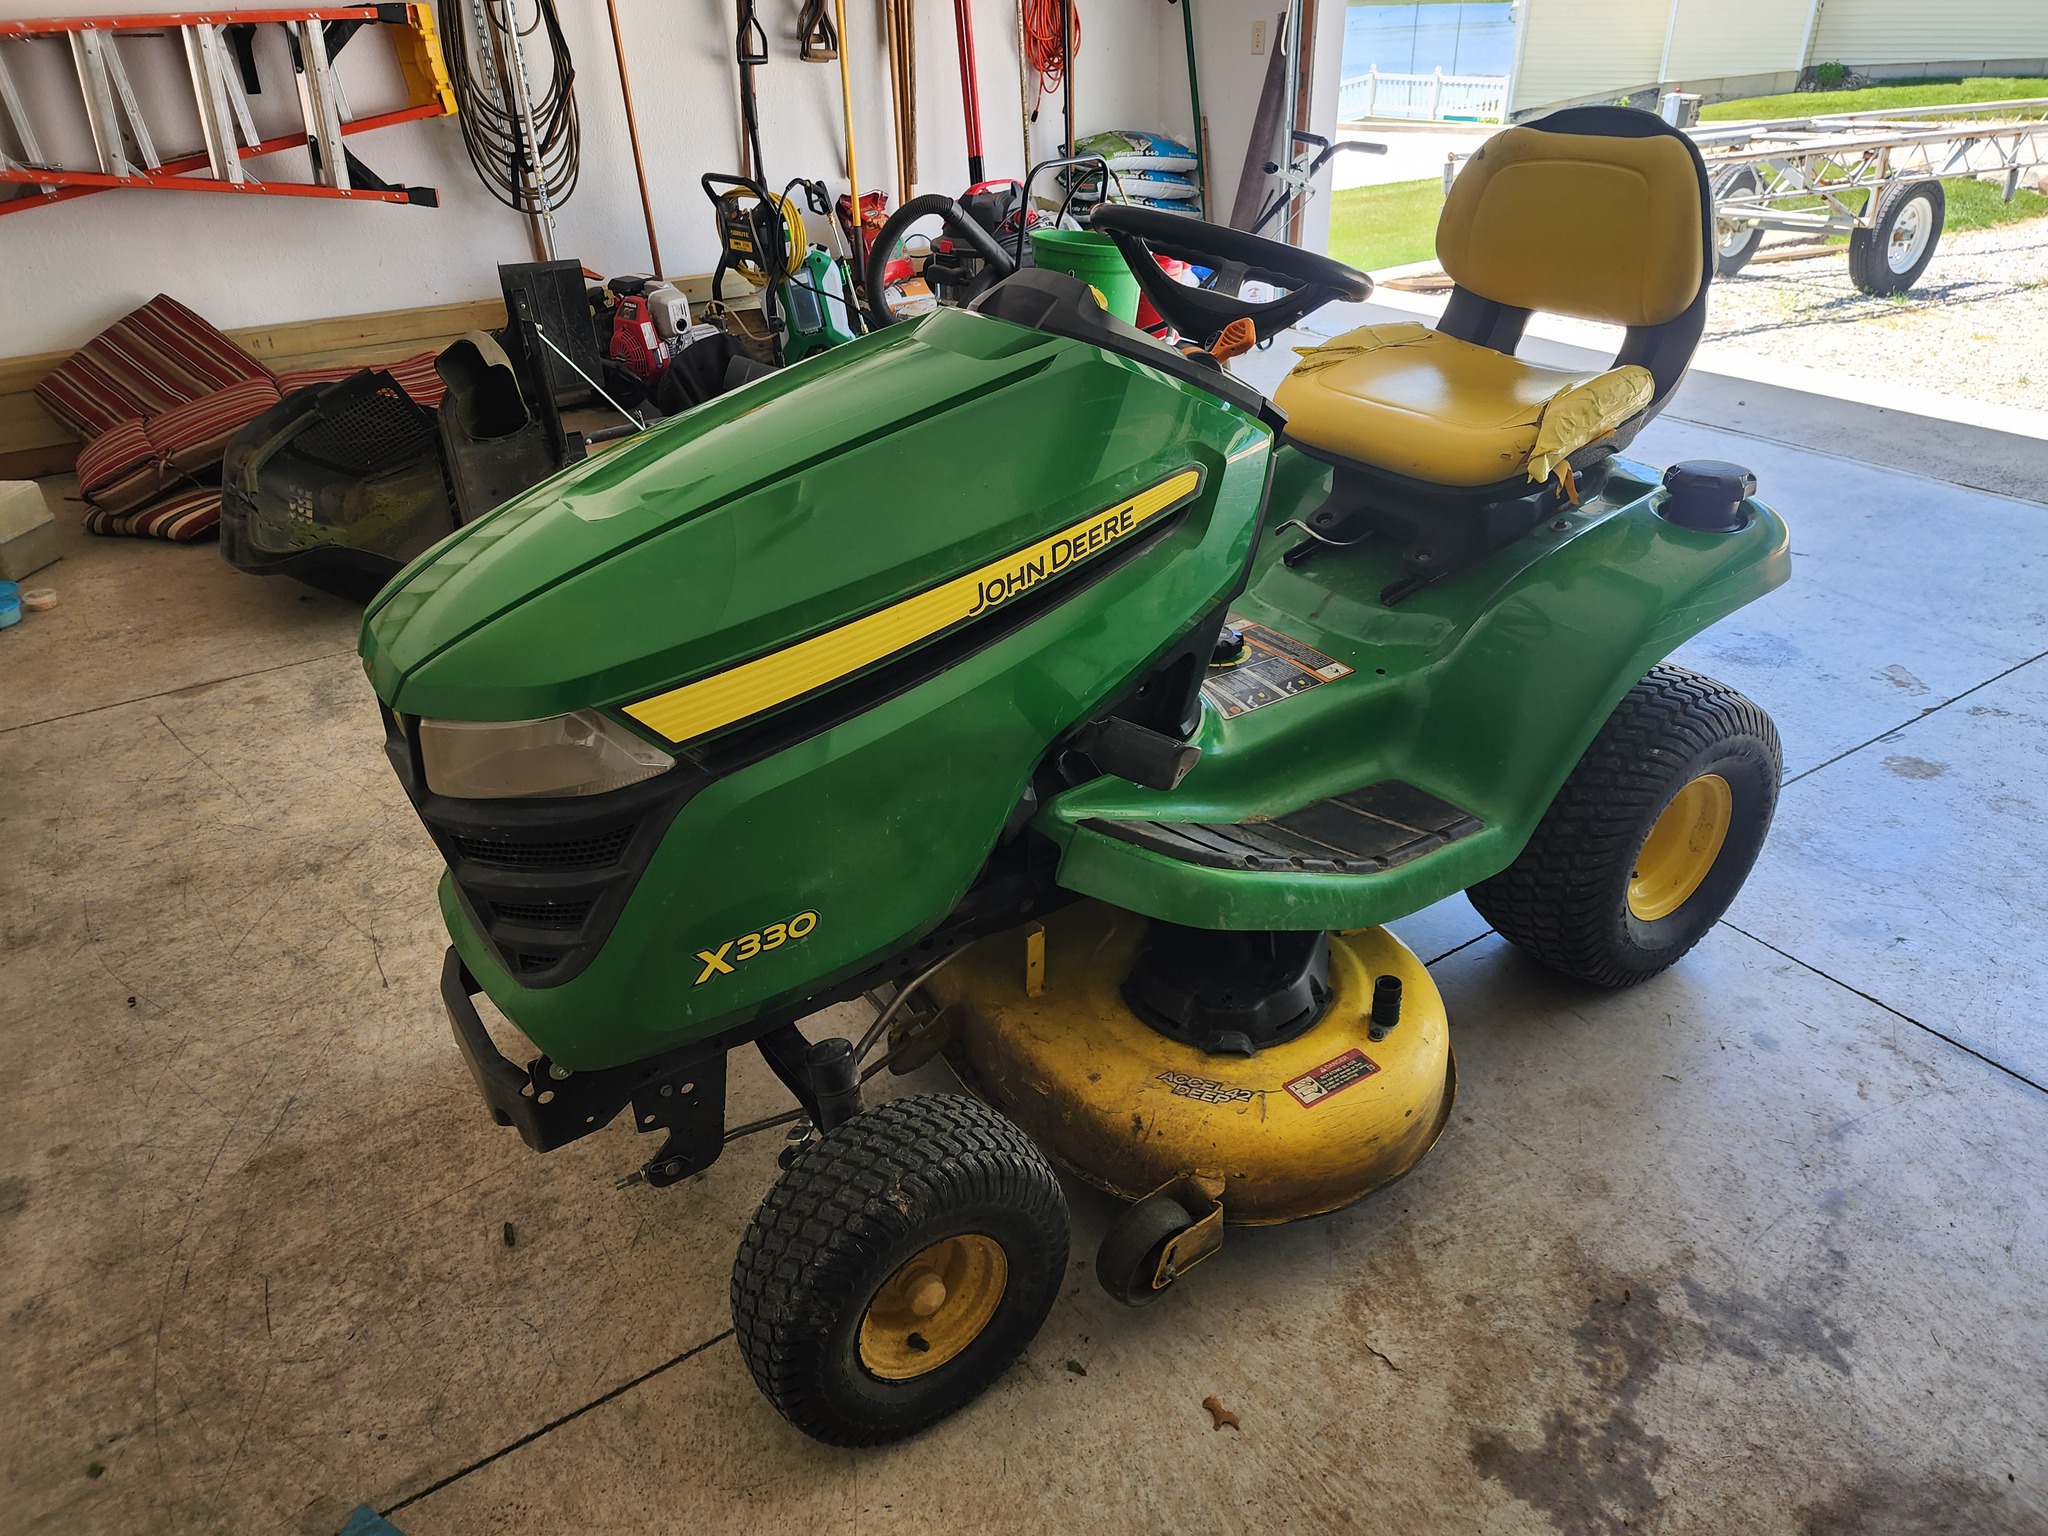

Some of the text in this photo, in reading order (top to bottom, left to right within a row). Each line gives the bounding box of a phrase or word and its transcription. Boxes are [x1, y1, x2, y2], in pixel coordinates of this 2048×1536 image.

[969, 505, 1135, 615] JOHN DEERE
[693, 910, 819, 986] X330
[1325, 1055, 1349, 1069] DANGER
[1156, 1071, 1253, 1103] ACCEL 42
[1171, 1084, 1230, 1104] DEEP
